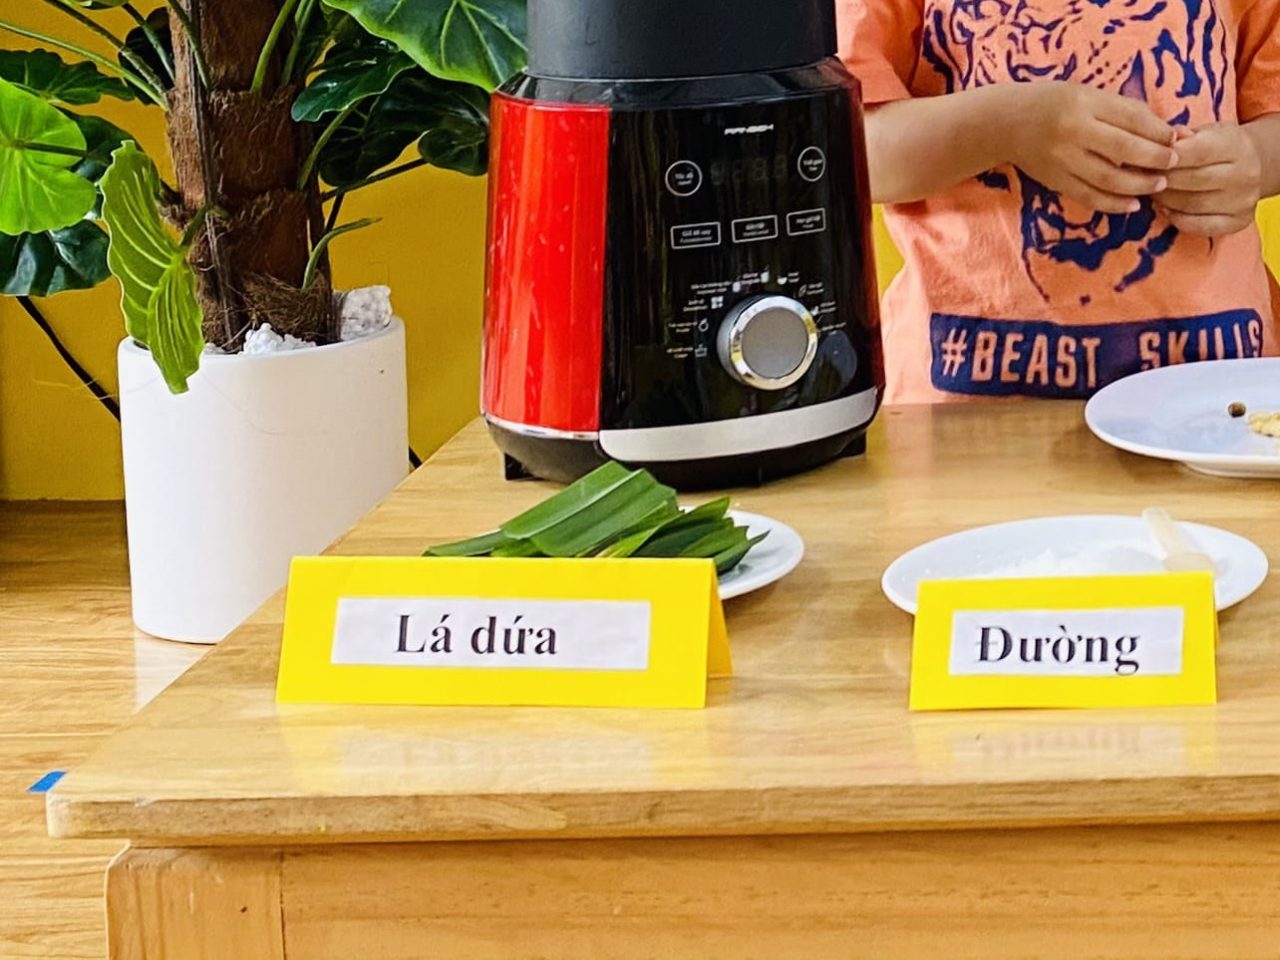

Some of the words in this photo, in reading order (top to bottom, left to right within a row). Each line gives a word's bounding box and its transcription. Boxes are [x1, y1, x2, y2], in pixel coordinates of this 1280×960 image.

[941, 327, 1101, 389] #BEAST
[393, 612, 454, 655] Lá
[470, 614, 558, 656] dứa
[975, 624, 1141, 676] Đường
